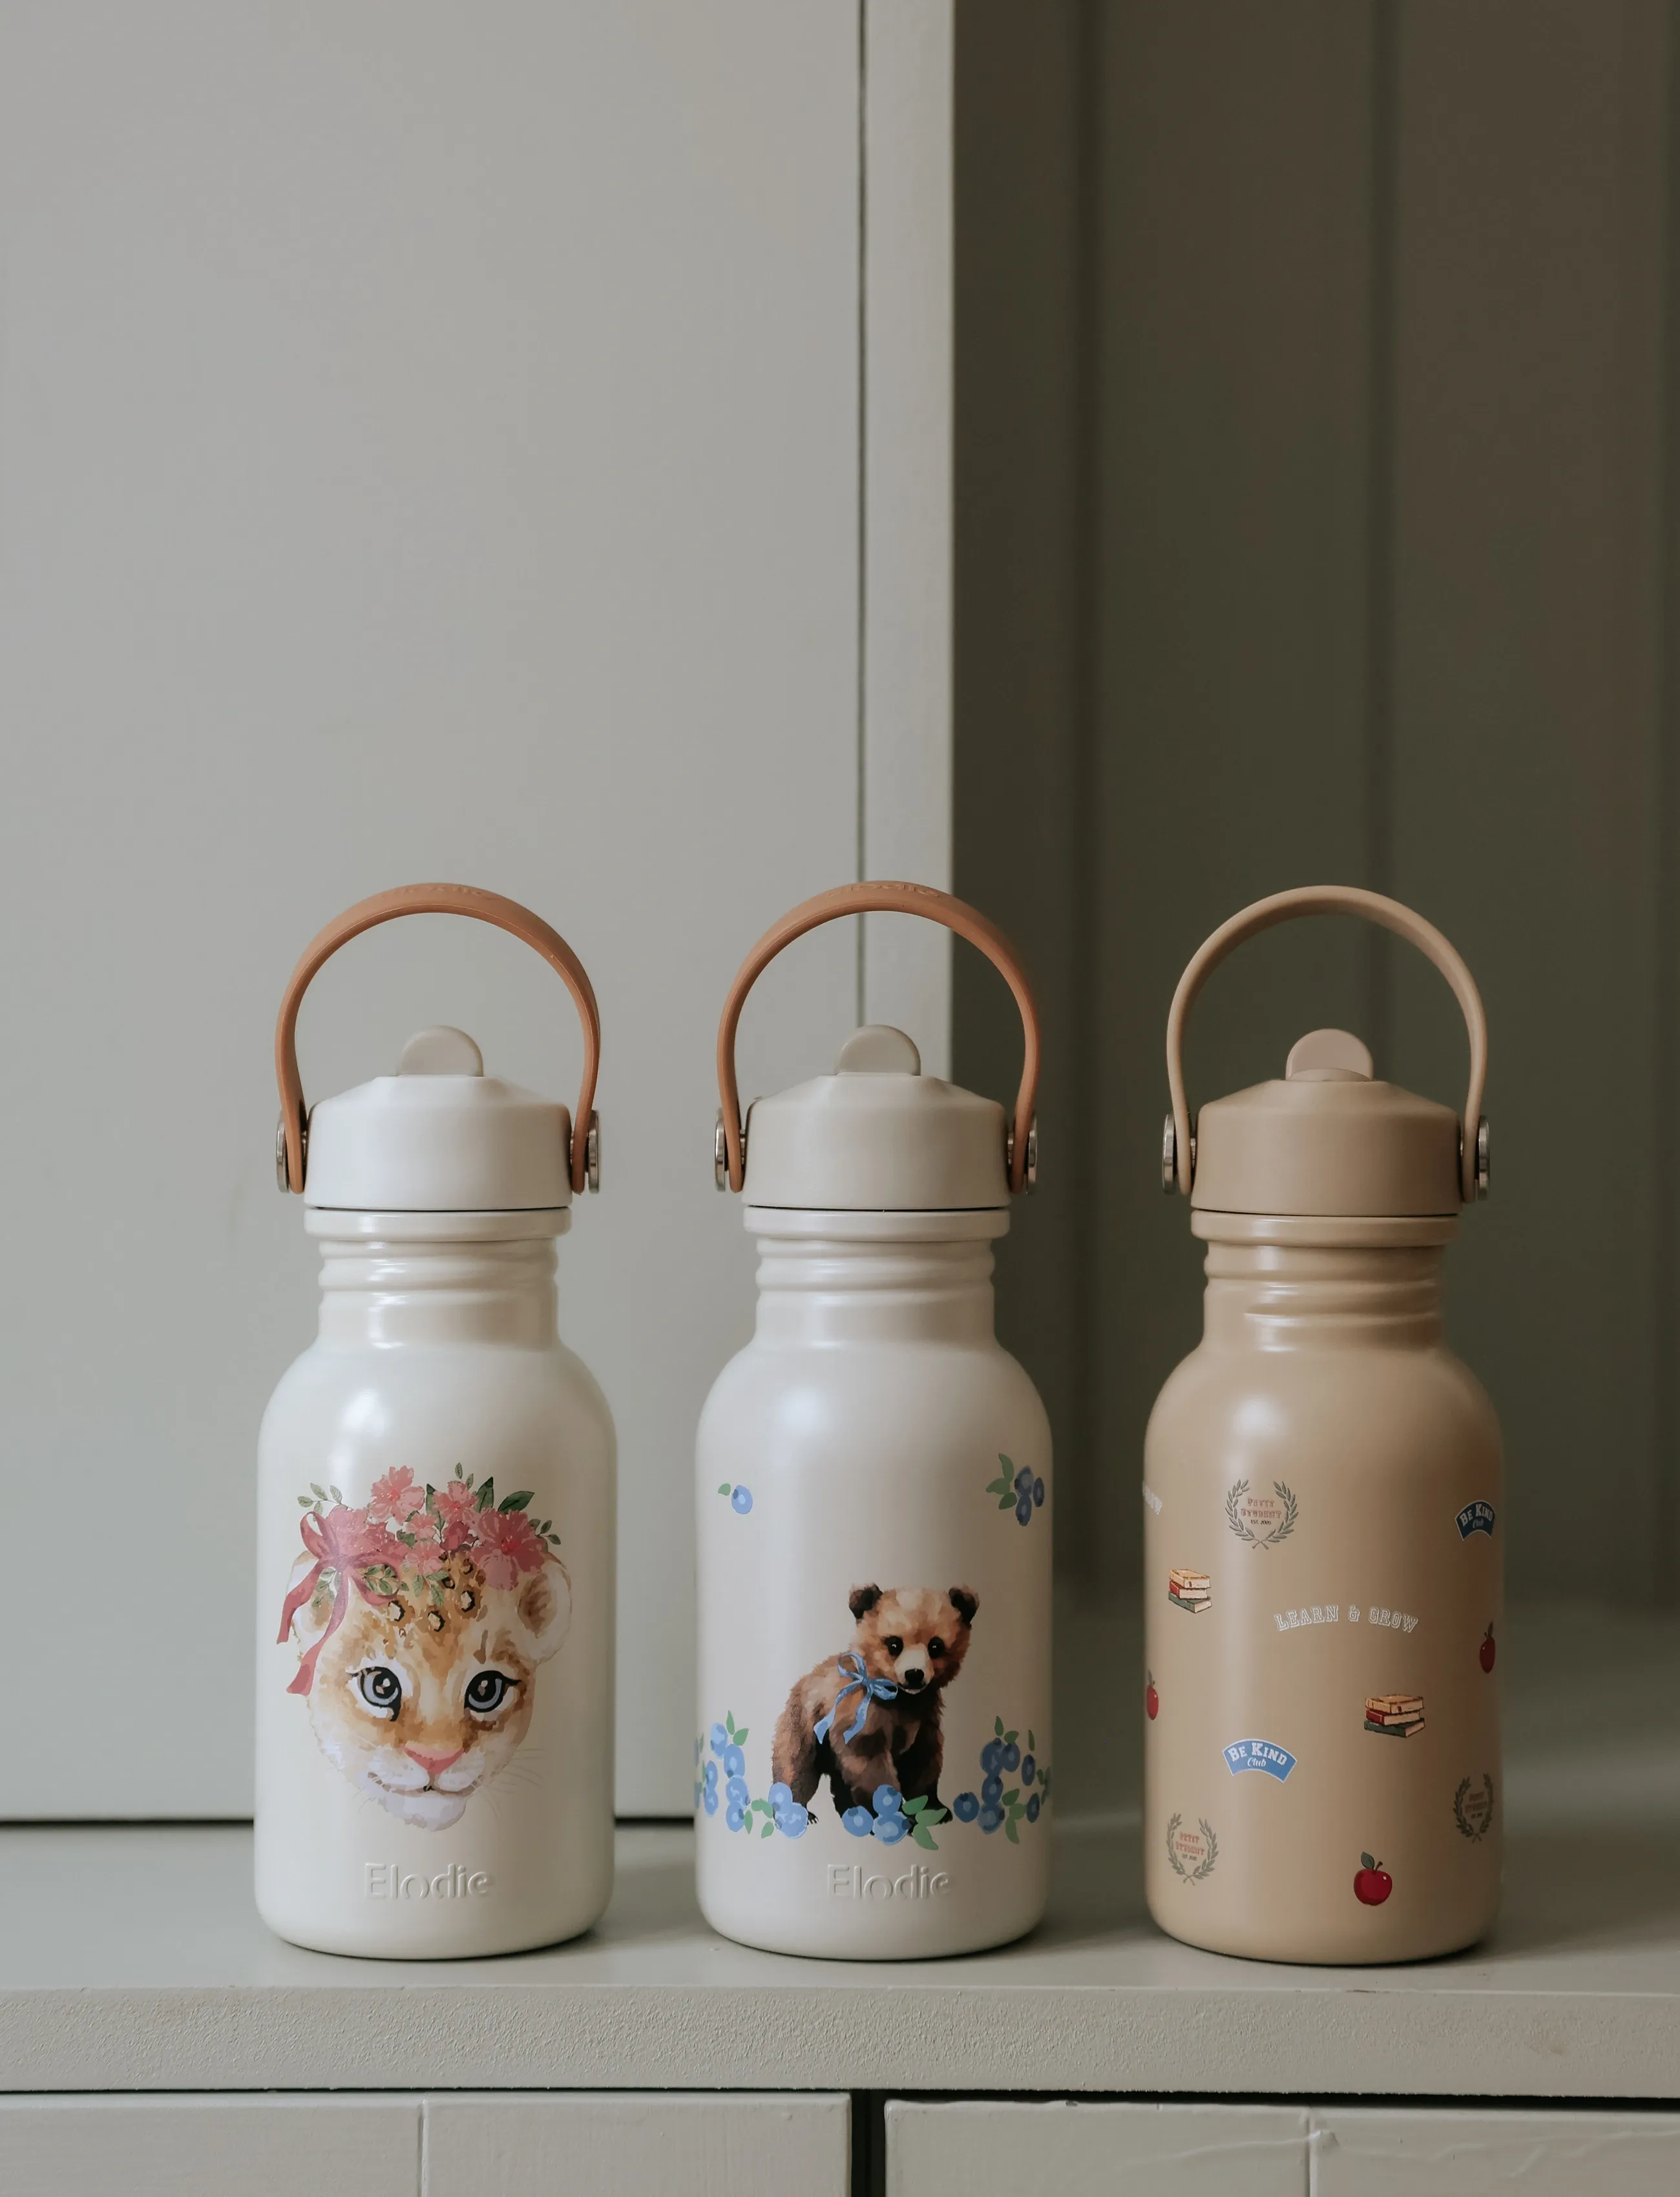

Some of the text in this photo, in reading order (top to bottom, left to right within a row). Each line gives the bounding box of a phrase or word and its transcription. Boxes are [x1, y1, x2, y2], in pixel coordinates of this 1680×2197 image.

[1241, 1508, 1282, 1519] STUDENT
[1274, 1604, 1418, 1634] LEARN & GROW
[1228, 1742, 1288, 1766] BE KIND
[1247, 1757, 1267, 1767] Club
[364, 1862, 494, 1900] Elodie
[826, 1864, 953, 1900] Elodie
